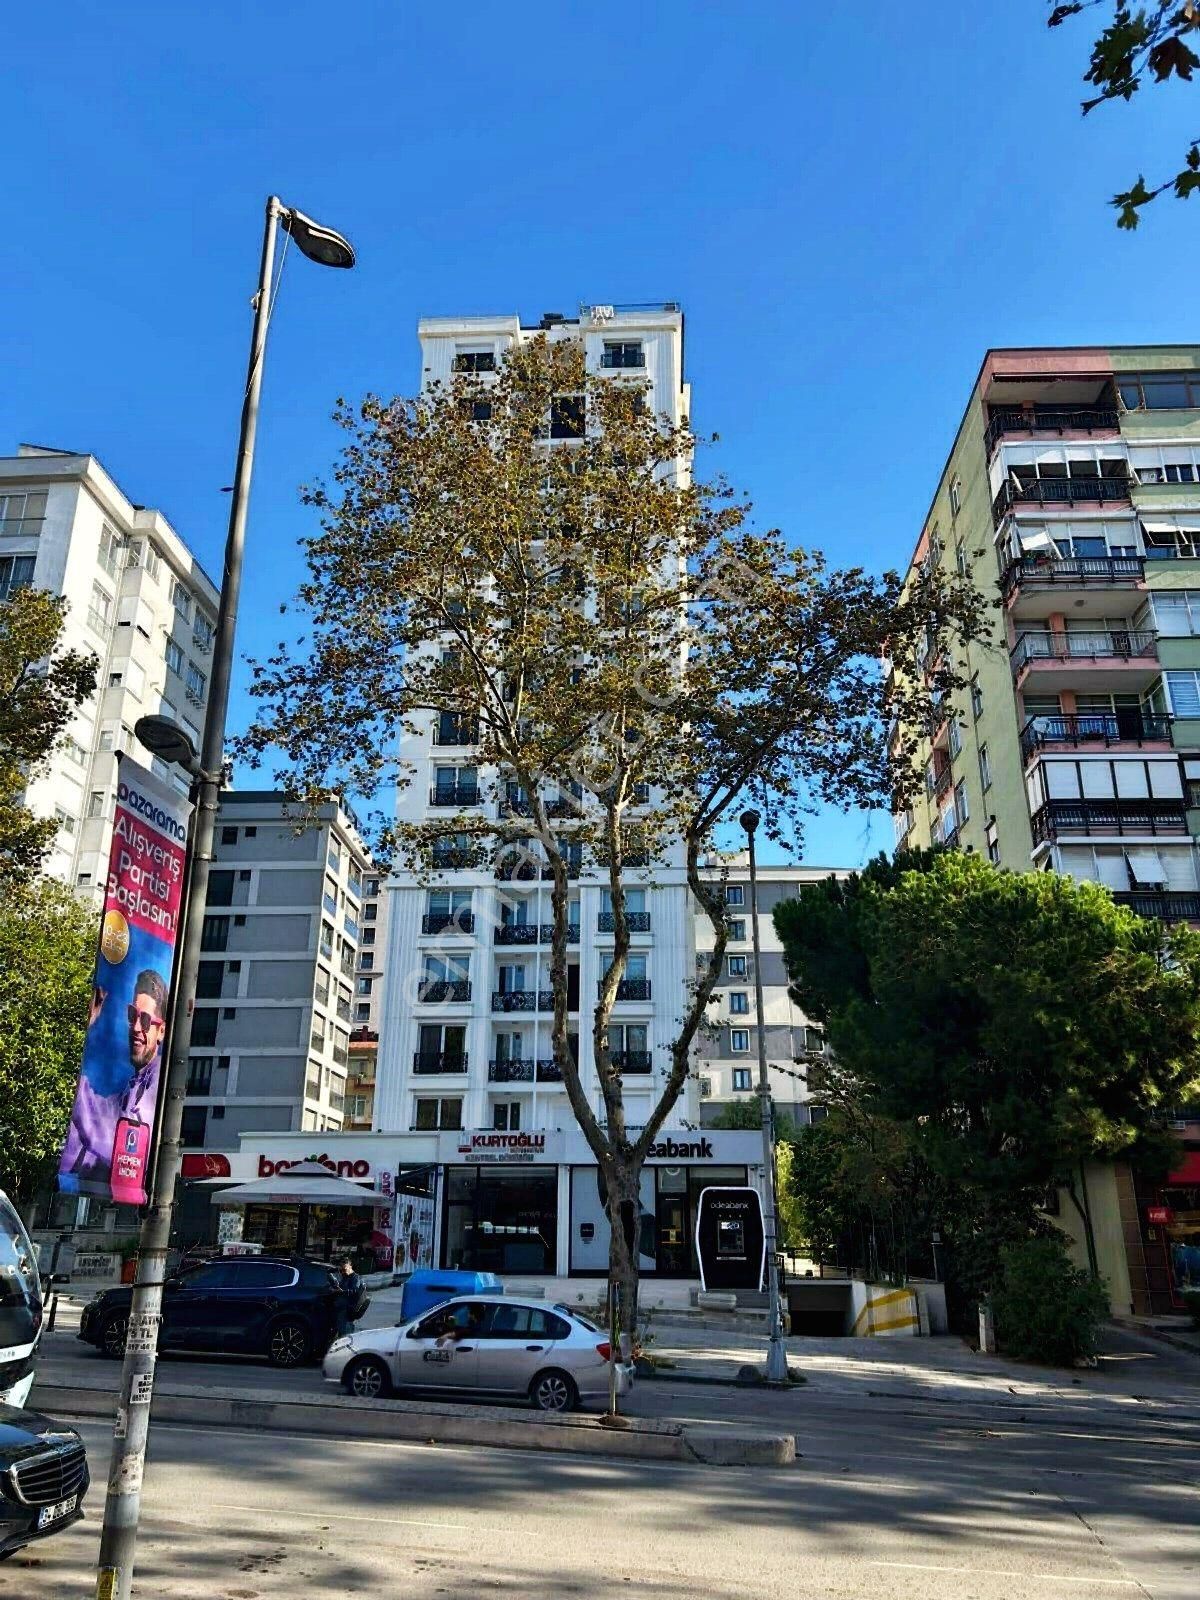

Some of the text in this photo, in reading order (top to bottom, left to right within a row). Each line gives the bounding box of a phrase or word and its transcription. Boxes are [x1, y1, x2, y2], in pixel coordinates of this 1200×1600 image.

[117, 782, 186, 843] pazarama
[114, 816, 181, 882] Alışveriş
[119, 850, 171, 902] Partisi
[107, 873, 177, 931] Başlasın!
[472, 1132, 545, 1148] KURTOĞLU
[645, 1137, 713, 1158] eabank
